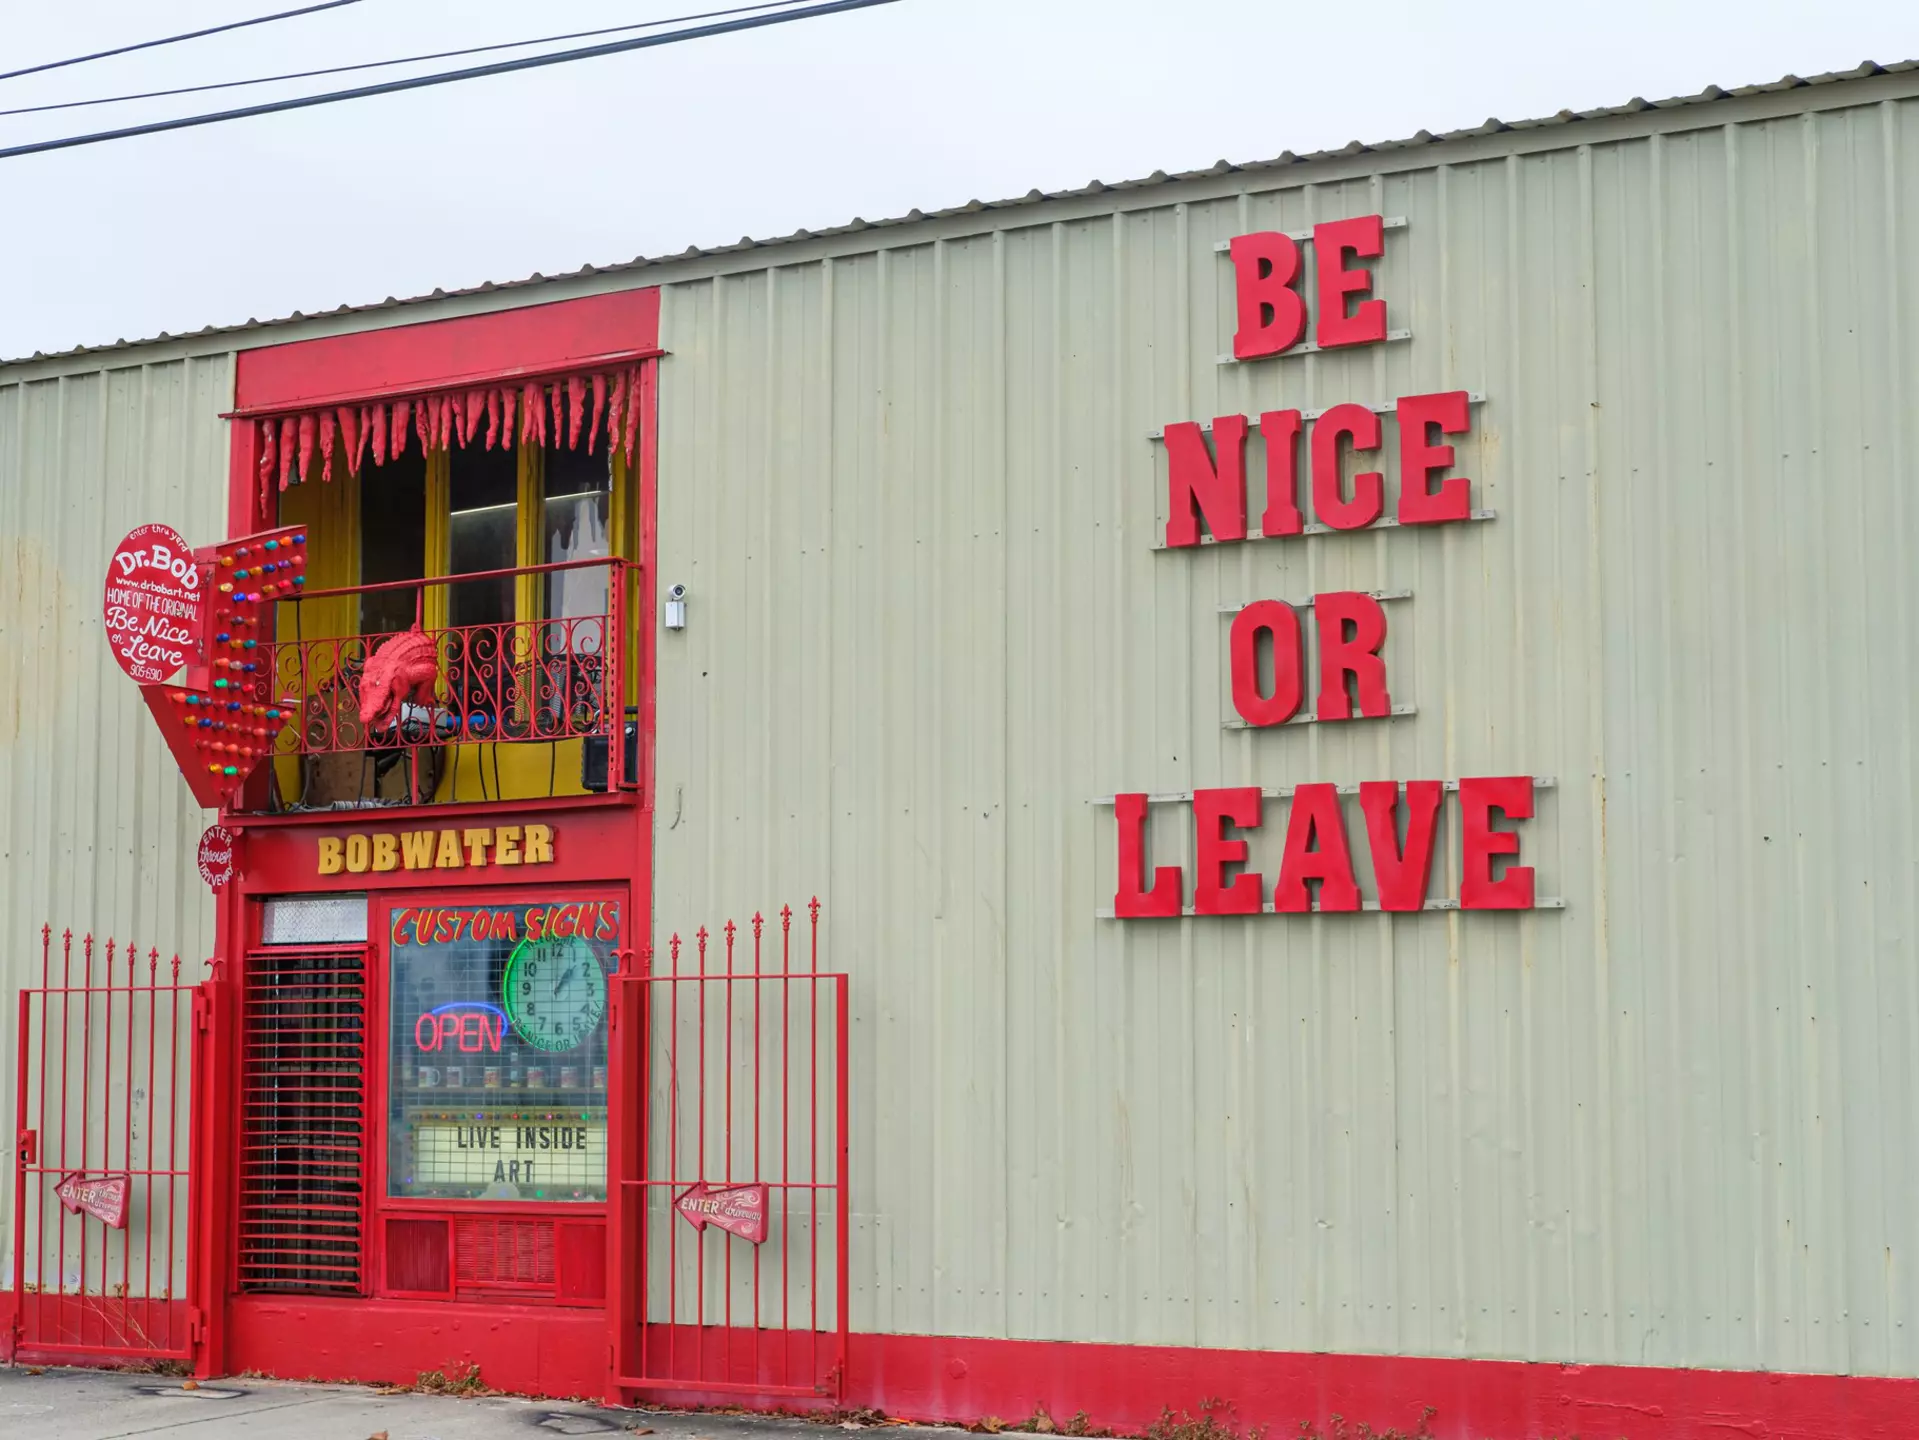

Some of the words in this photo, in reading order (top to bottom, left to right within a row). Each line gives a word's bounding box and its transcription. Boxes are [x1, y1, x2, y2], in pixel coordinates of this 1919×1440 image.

[1229, 214, 1387, 361] BE
[1163, 390, 1471, 548] NICE
[129, 526, 149, 540] enter
[151, 524, 170, 535] thru
[169, 532, 188, 552] yard
[115, 577, 201, 602] www.drbobart.net
[107, 587, 132, 606] HOME
[132, 591, 144, 609] OF
[145, 593, 161, 614] THE
[161, 597, 198, 622] ORIGINAL
[106, 606, 139, 631] Be
[139, 615, 193, 645] Nice
[111, 633, 124, 645] or
[121, 635, 184, 666] Leave
[1229, 591, 1392, 728] OR
[202, 826, 233, 847] ENTER
[1114, 775, 1535, 919] LEAVE
[199, 847, 232, 864] through
[318, 824, 554, 875] BOBWATER
[199, 861, 233, 886] DRIVEWAY
[392, 908, 517, 947] CUSTOM
[525, 902, 619, 942] SIGNS
[551, 942, 563, 957] 12
[524, 962, 537, 977] 10
[581, 962, 591, 977] 2
[522, 982, 531, 996] 9
[586, 982, 594, 997] 3
[527, 1002, 535, 1016] 8
[415, 1013, 502, 1052] OPEN
[538, 1017, 546, 1030] 7
[555, 1022, 563, 1035] 6
[457, 1126, 500, 1149] LIVE
[517, 1126, 586, 1150] INSIDE
[493, 1160, 533, 1183] ART
[61, 1184, 96, 1204] ENTER
[681, 1198, 720, 1214] ENTER
